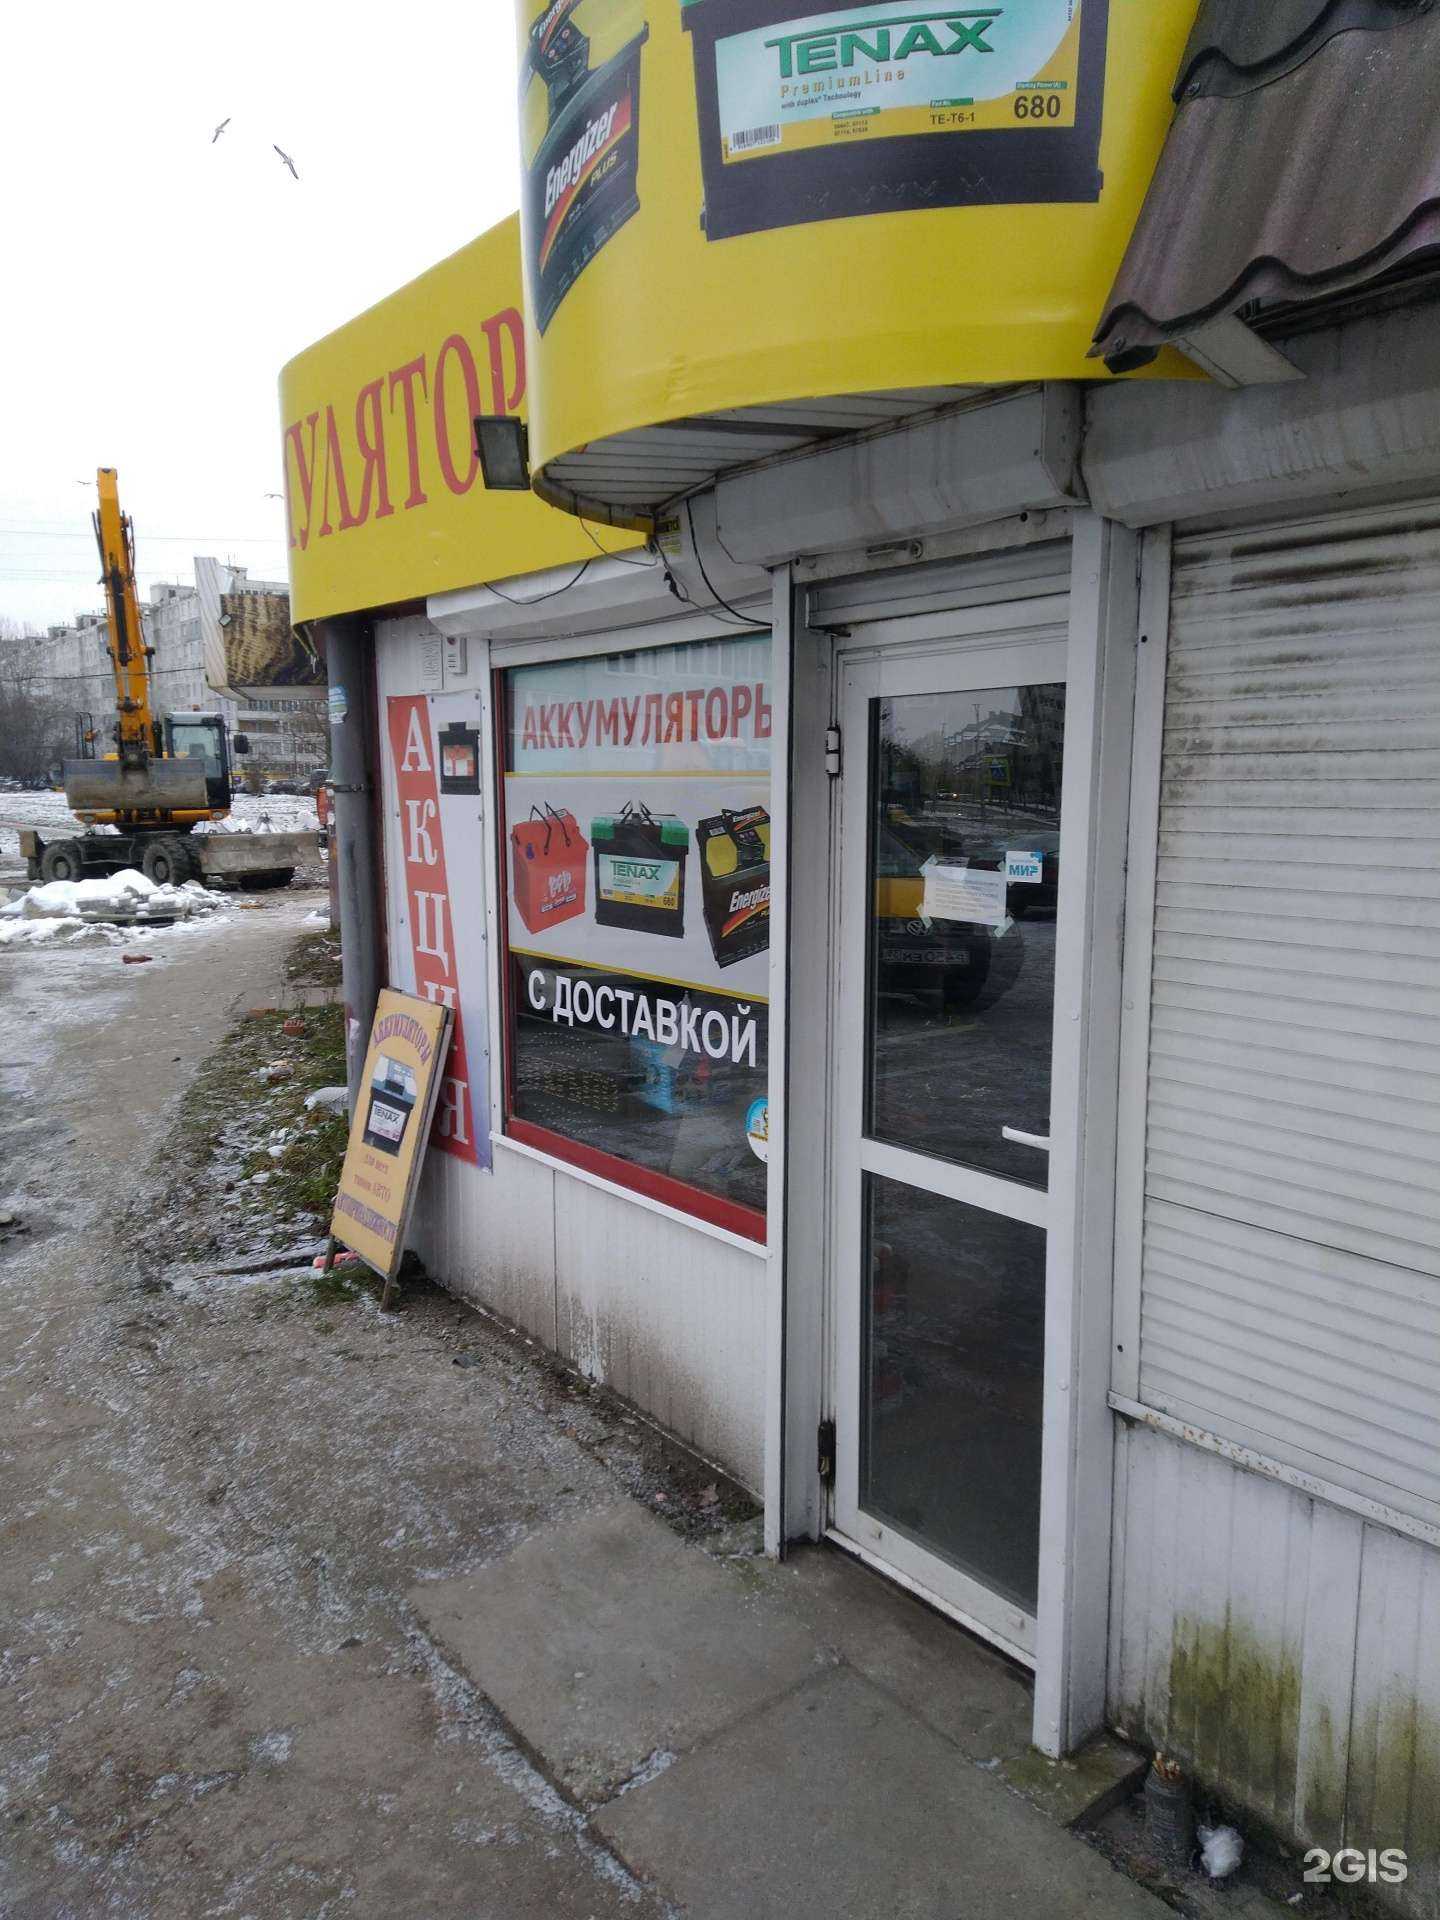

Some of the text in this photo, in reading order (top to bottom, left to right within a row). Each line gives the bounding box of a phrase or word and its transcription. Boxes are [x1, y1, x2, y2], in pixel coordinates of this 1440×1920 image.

[764, 8, 1004, 79] TENAX
[930, 112, 975, 125] TE-T6-1
[1013, 94, 1061, 120] 680
[544, 102, 618, 219] Energizer
[284, 306, 527, 551] УЛЯТОР
[610, 860, 661, 881] TENAX
[1009, 864, 1039, 877] МИР
[528, 969, 757, 1068] С ДОСТАВКОЙ
